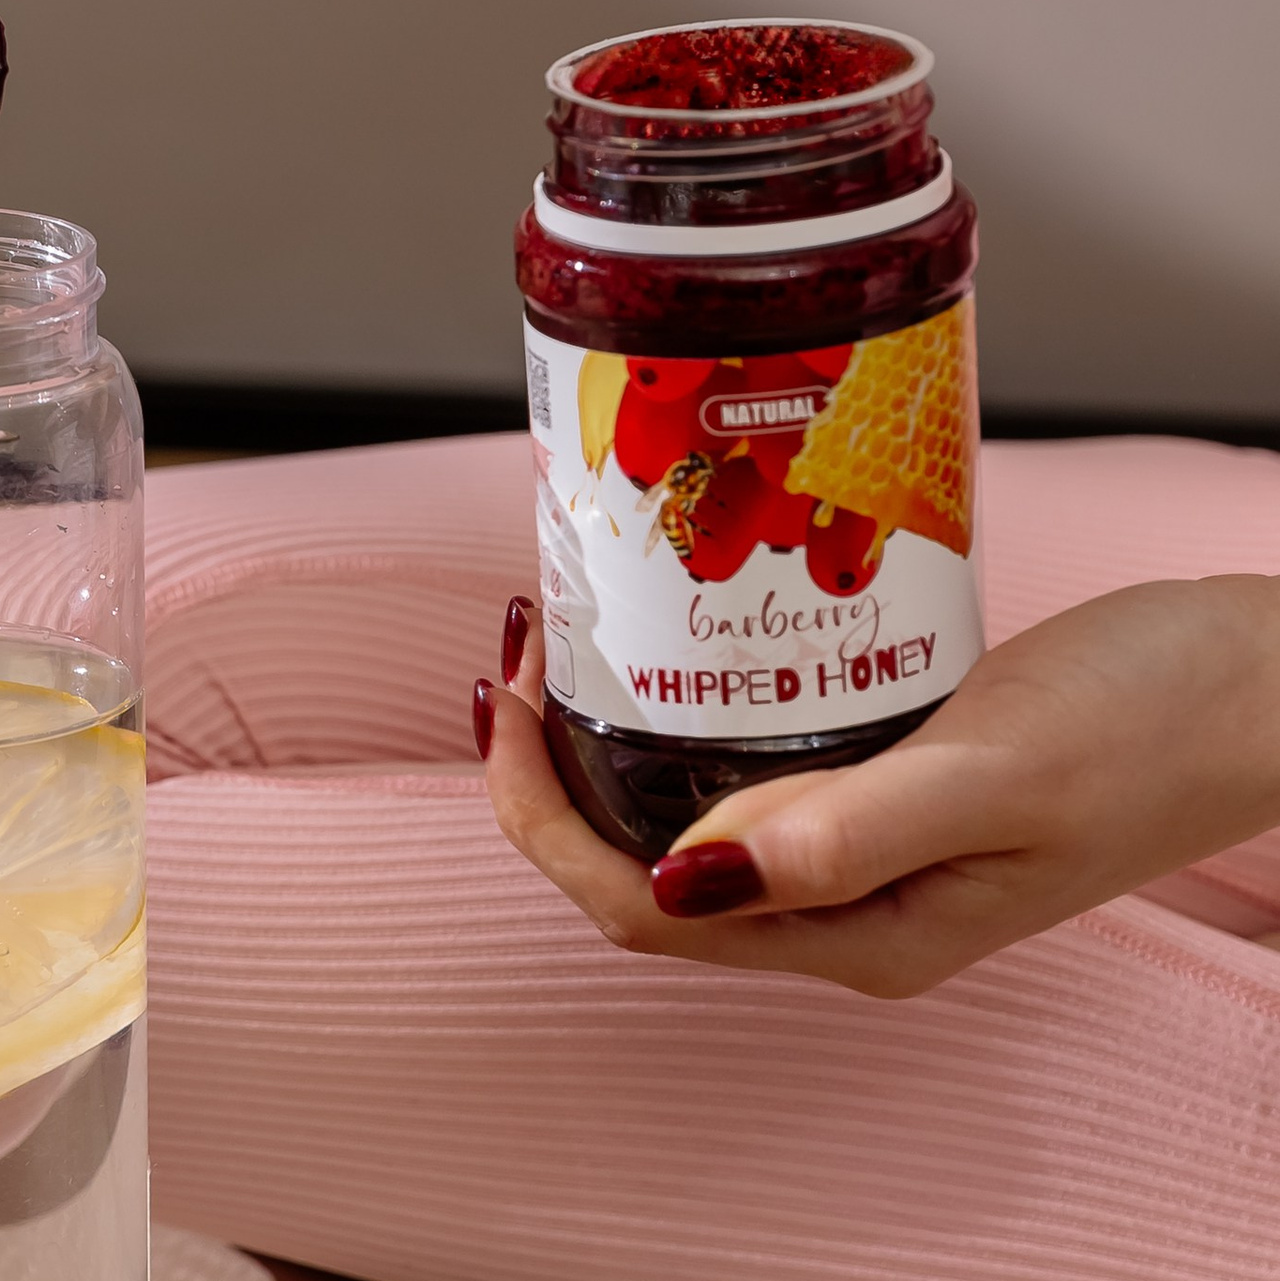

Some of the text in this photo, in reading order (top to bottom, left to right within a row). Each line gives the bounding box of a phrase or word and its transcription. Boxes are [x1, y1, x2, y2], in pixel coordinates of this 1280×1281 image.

[721, 396, 816, 427] NATURAL
[689, 591, 889, 662] barberry
[627, 632, 936, 706] WHIPPED HONEY
